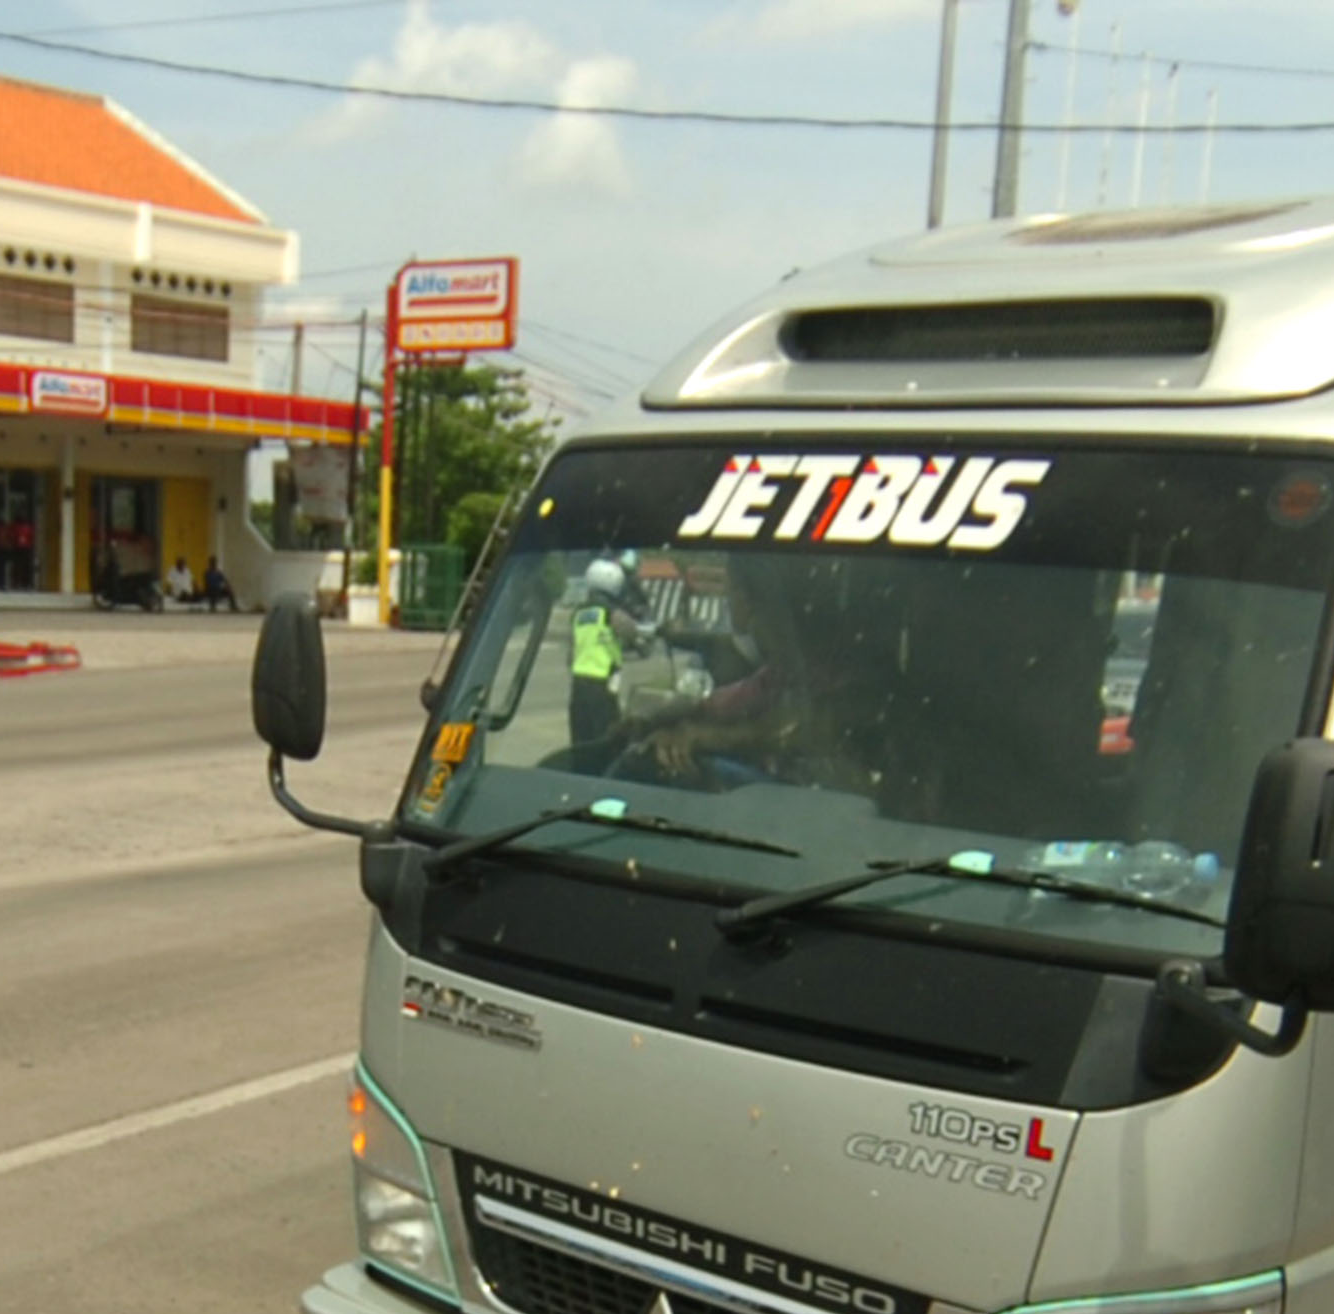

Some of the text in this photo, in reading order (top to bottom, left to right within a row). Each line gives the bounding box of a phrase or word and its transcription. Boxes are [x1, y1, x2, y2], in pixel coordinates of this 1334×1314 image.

[407, 262, 501, 294] Alfamart
[908, 1101, 1021, 1154] 110PS
[843, 1132, 1047, 1200] CANTER
[472, 1164, 727, 1265] MITSUBISHI
